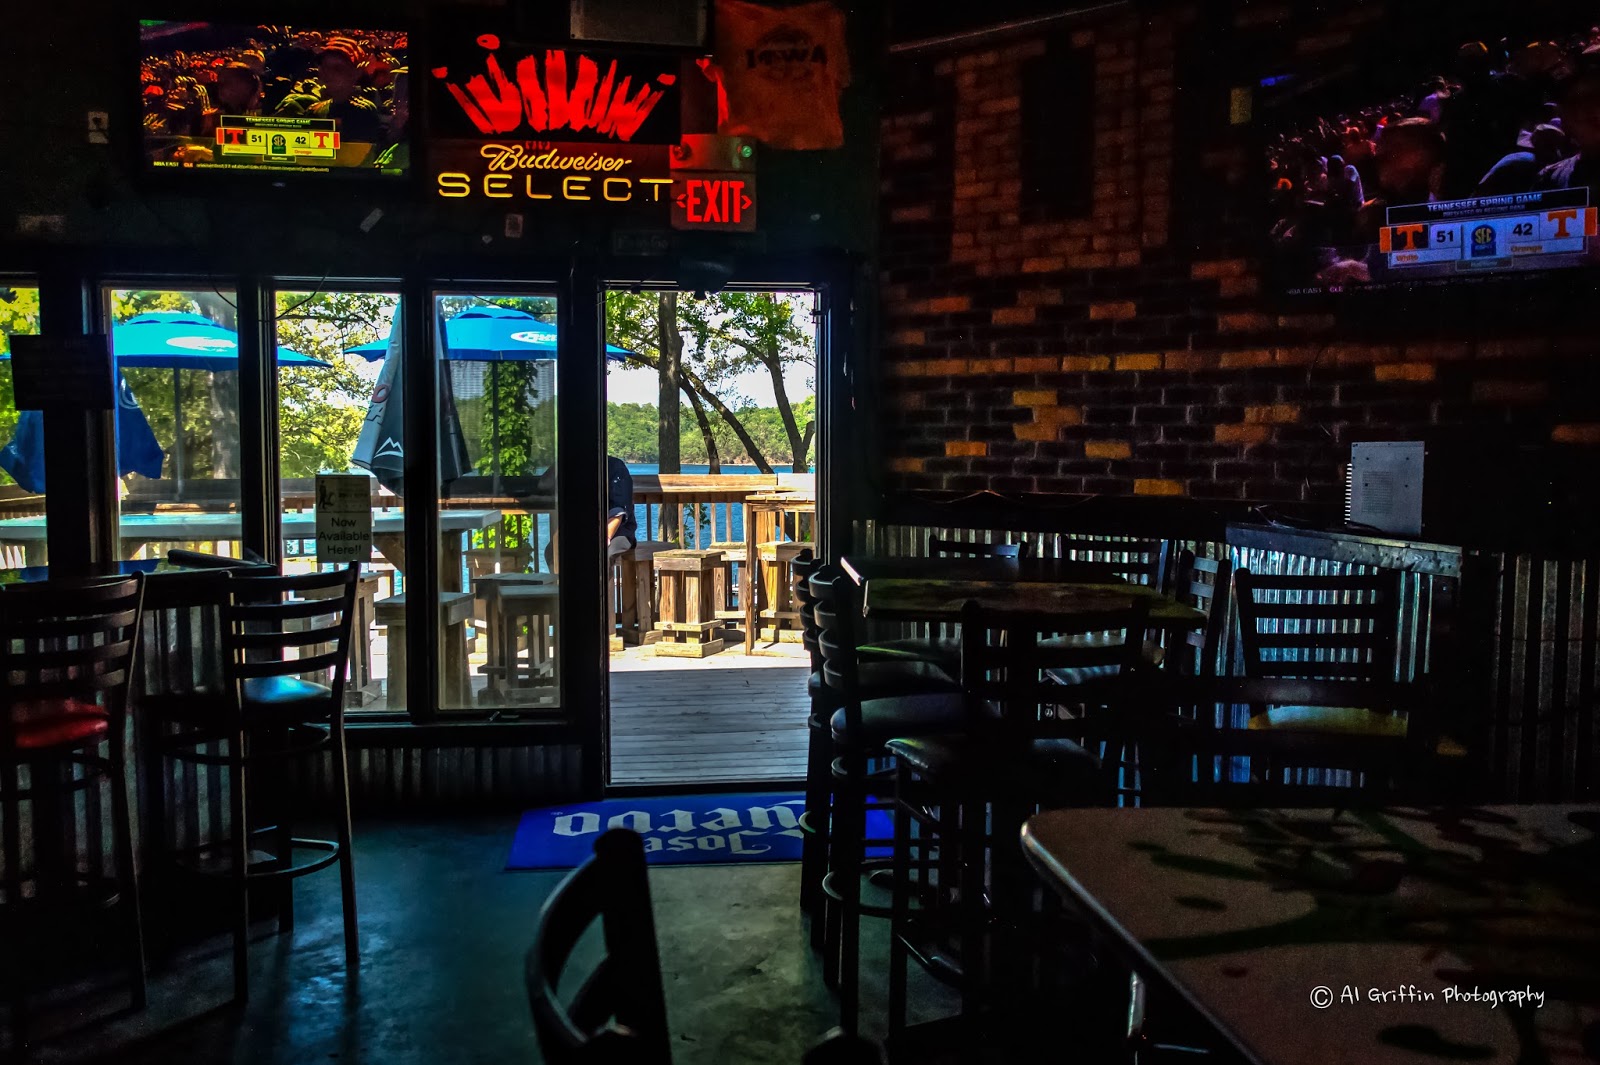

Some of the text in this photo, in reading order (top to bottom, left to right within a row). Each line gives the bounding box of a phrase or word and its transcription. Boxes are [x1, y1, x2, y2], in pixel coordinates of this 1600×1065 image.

[226, 129, 244, 145] T
[251, 134, 262, 143] 51
[295, 136, 307, 144] 42
[313, 132, 330, 148] T
[480, 143, 632, 171] Budweiser
[438, 172, 674, 202] SELECT
[685, 179, 745, 223] EXIT
[1427, 193, 1543, 212] TENNESSEE SPRING GAME
[1512, 222, 1533, 236] 42
[1547, 209, 1577, 238] T
[1396, 223, 1424, 250] T
[1436, 230, 1454, 243] 51
[1474, 227, 1493, 245] SEC
[1395, 254, 1419, 262] White
[331, 517, 357, 527] Now
[318, 531, 370, 541] Available
[327, 544, 362, 555] Here!!
[643, 829, 772, 854] Jose
